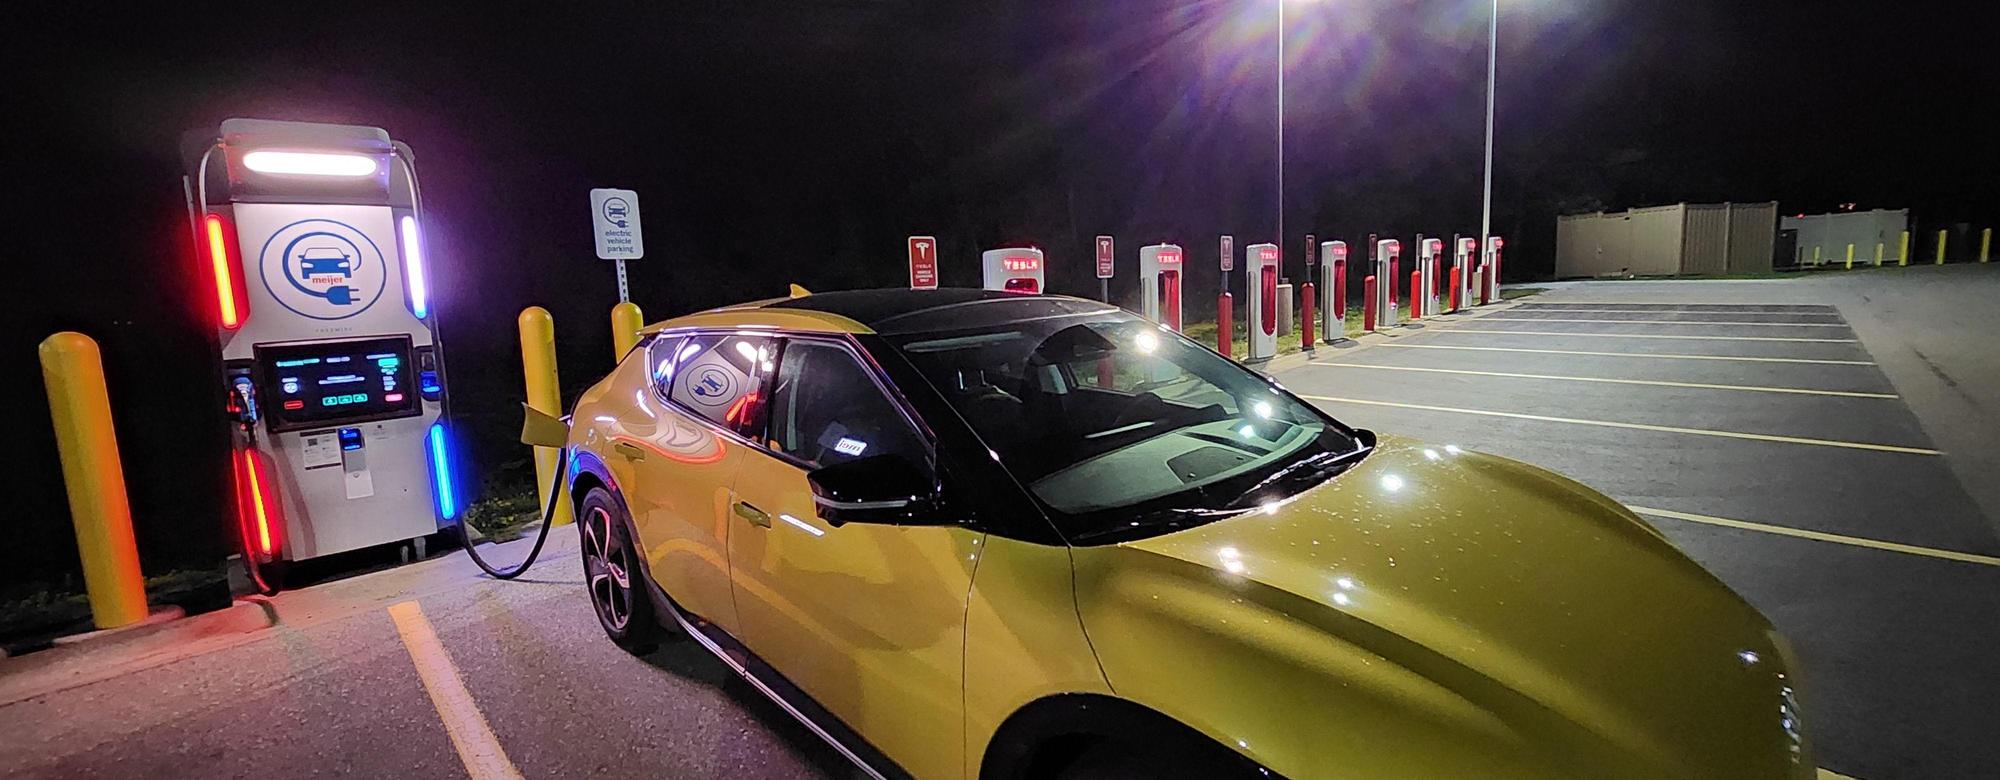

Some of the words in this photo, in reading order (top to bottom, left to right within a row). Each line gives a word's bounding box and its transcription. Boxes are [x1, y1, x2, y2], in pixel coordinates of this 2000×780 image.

[607, 245, 634, 253] parking
[1004, 259, 1038, 270] TESLA
[312, 275, 343, 285] meijer
